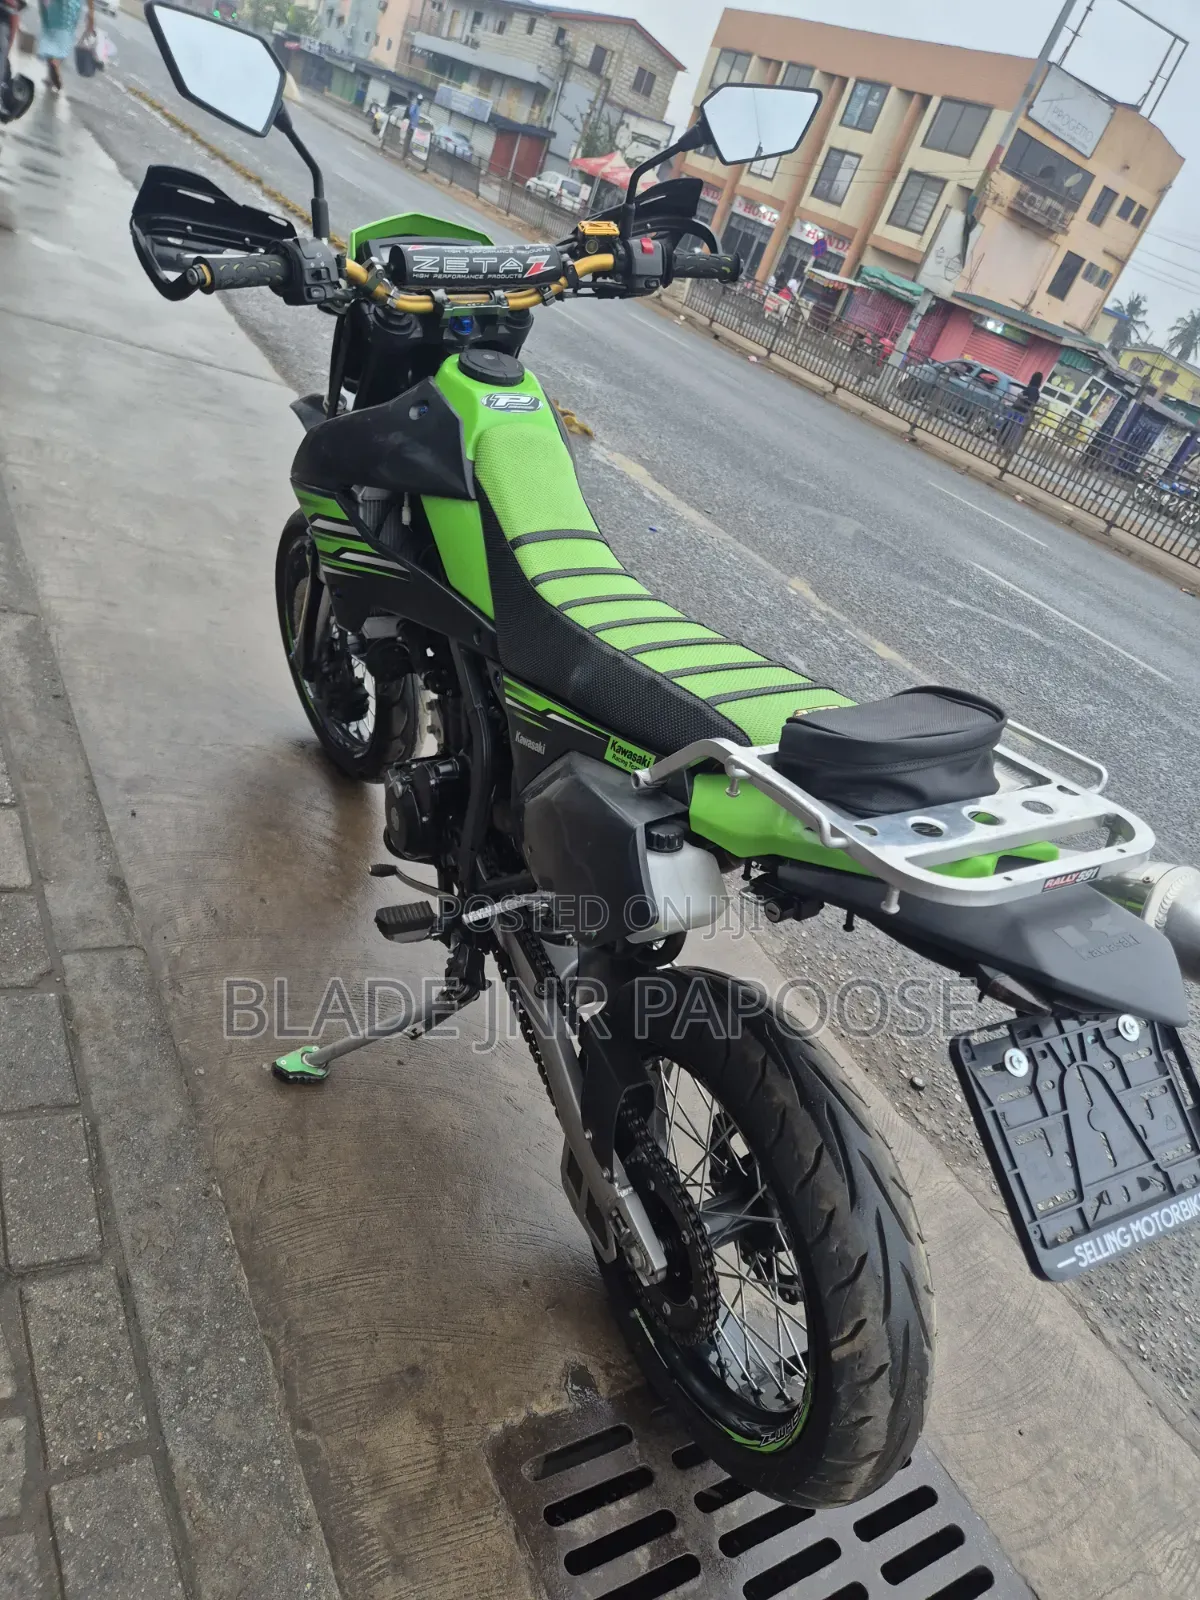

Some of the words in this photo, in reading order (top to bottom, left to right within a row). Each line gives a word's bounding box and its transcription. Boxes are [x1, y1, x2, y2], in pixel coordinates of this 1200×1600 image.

[412, 255, 524, 274] ZETA
[515, 730, 546, 755] Kawasaki
[610, 739, 652, 769] Kawasaki
[611, 753, 630, 769] Racing
[1074, 1227, 1131, 1268] SELLING
[1129, 1192, 1200, 1243] MOTORBIK
